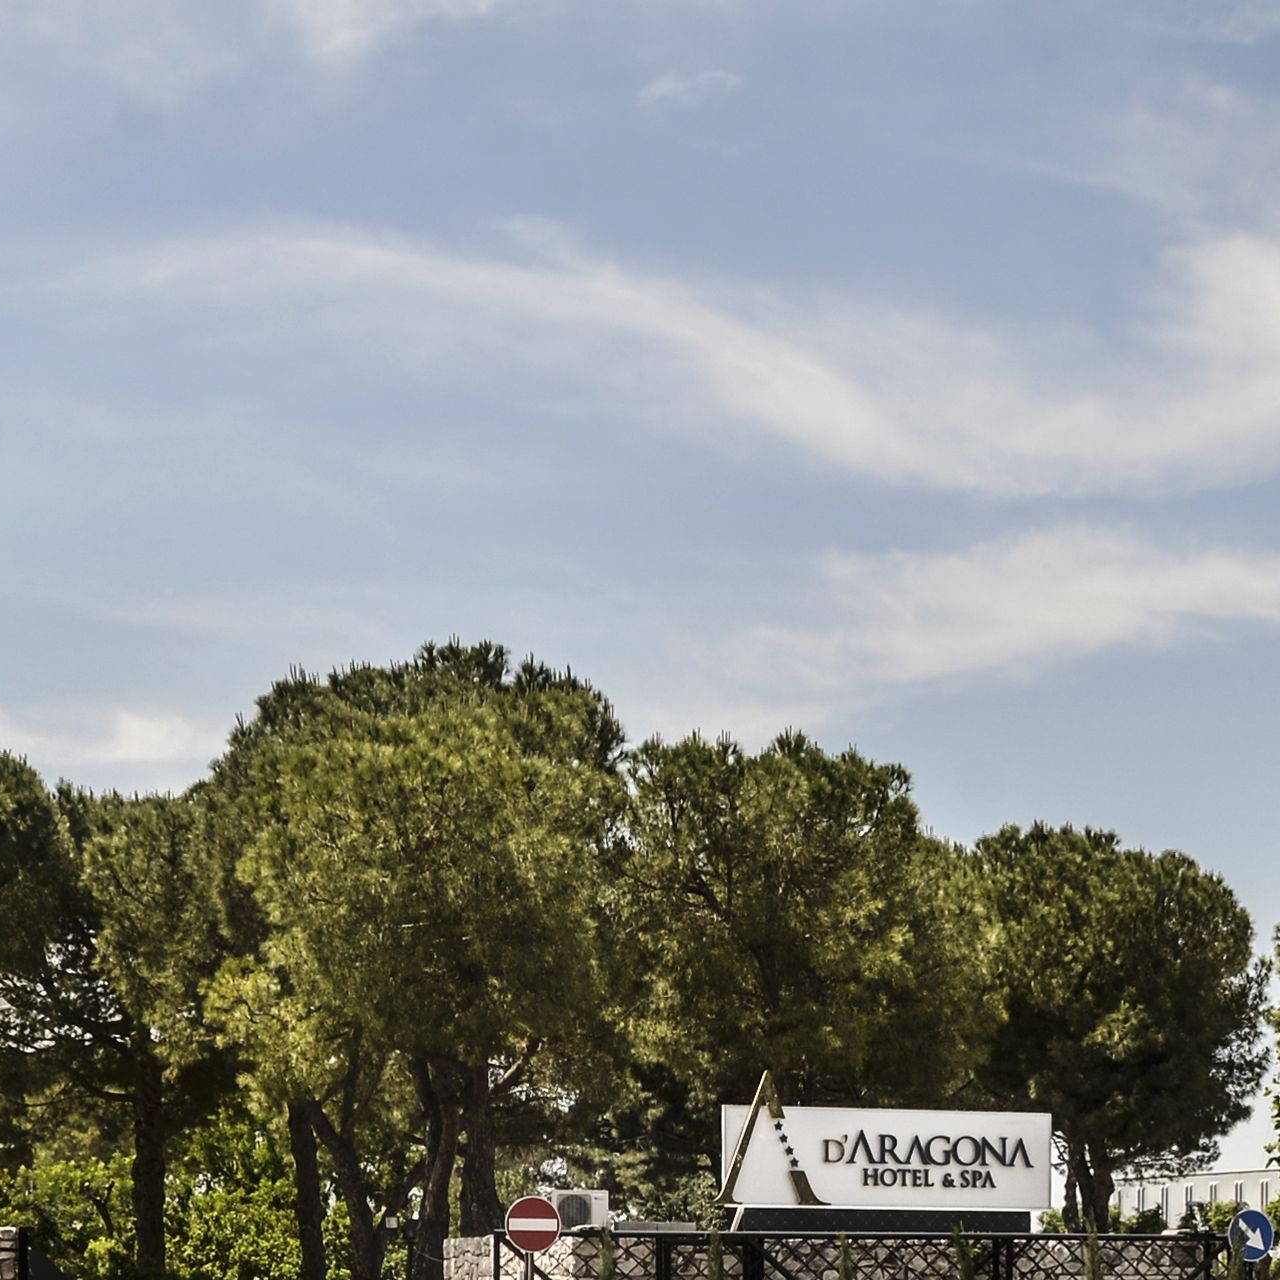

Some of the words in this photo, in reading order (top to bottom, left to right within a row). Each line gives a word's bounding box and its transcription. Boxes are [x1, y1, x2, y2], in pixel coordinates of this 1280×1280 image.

[822, 1129, 1034, 1168] D'ARAGONA
[863, 1168, 934, 1188] HOTEL
[941, 1173, 956, 1188] &
[959, 1170, 996, 1189] SPA
